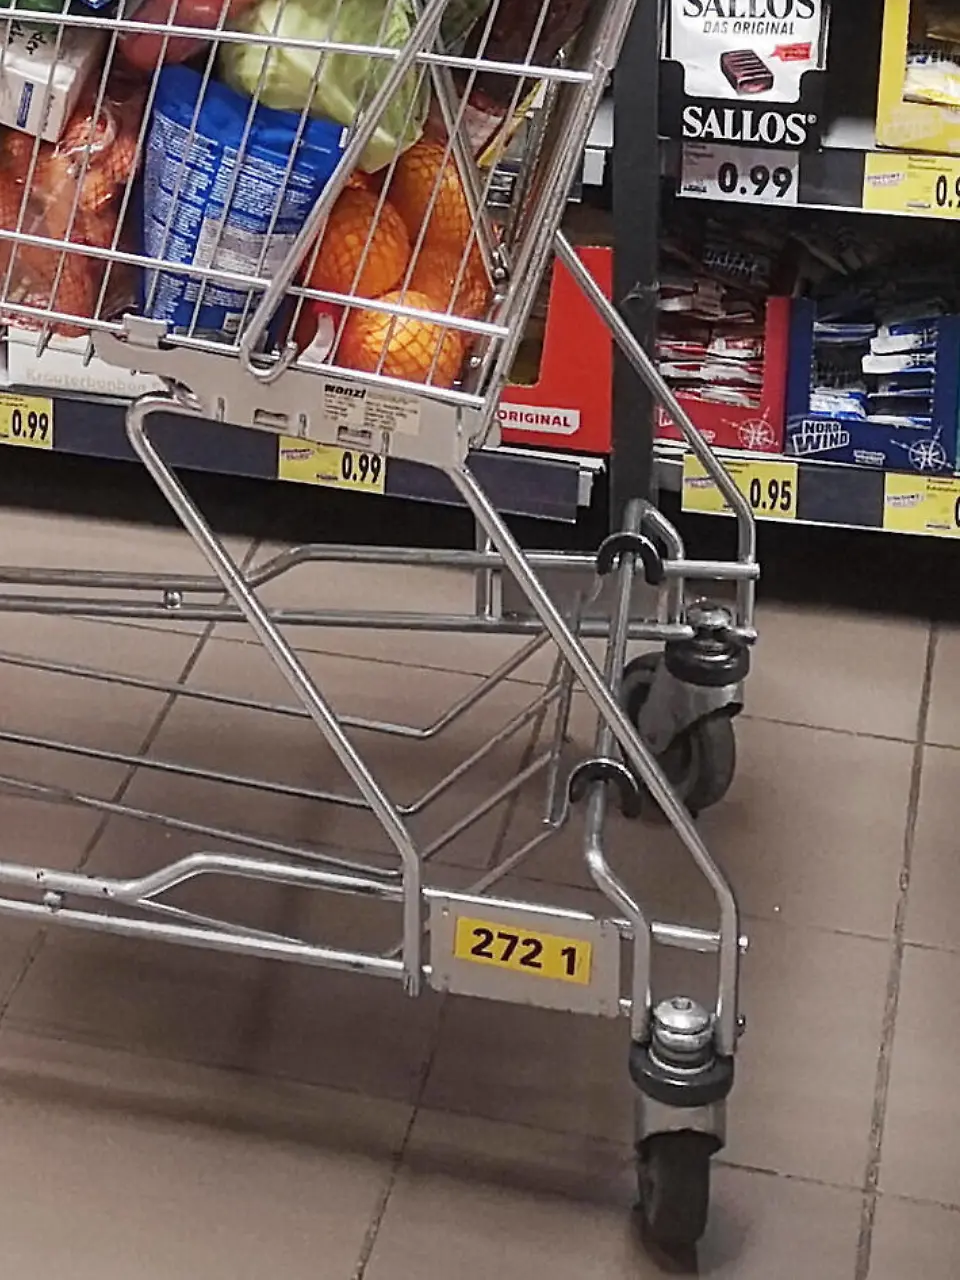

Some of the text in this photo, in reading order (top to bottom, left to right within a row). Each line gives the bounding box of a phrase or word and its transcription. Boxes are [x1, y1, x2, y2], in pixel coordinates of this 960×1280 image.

[703, 21, 796, 36] DAS ORIGINAL
[717, 162, 793, 198] 0.99
[12, 409, 49, 441] 0.99
[497, 409, 572, 428] ORIGINAL
[803, 420, 840, 435] NORD
[793, 430, 851, 455] WIND
[341, 451, 382, 484] 0.99
[749, 477, 793, 512] 0.95
[471, 927, 577, 976] 272 1
